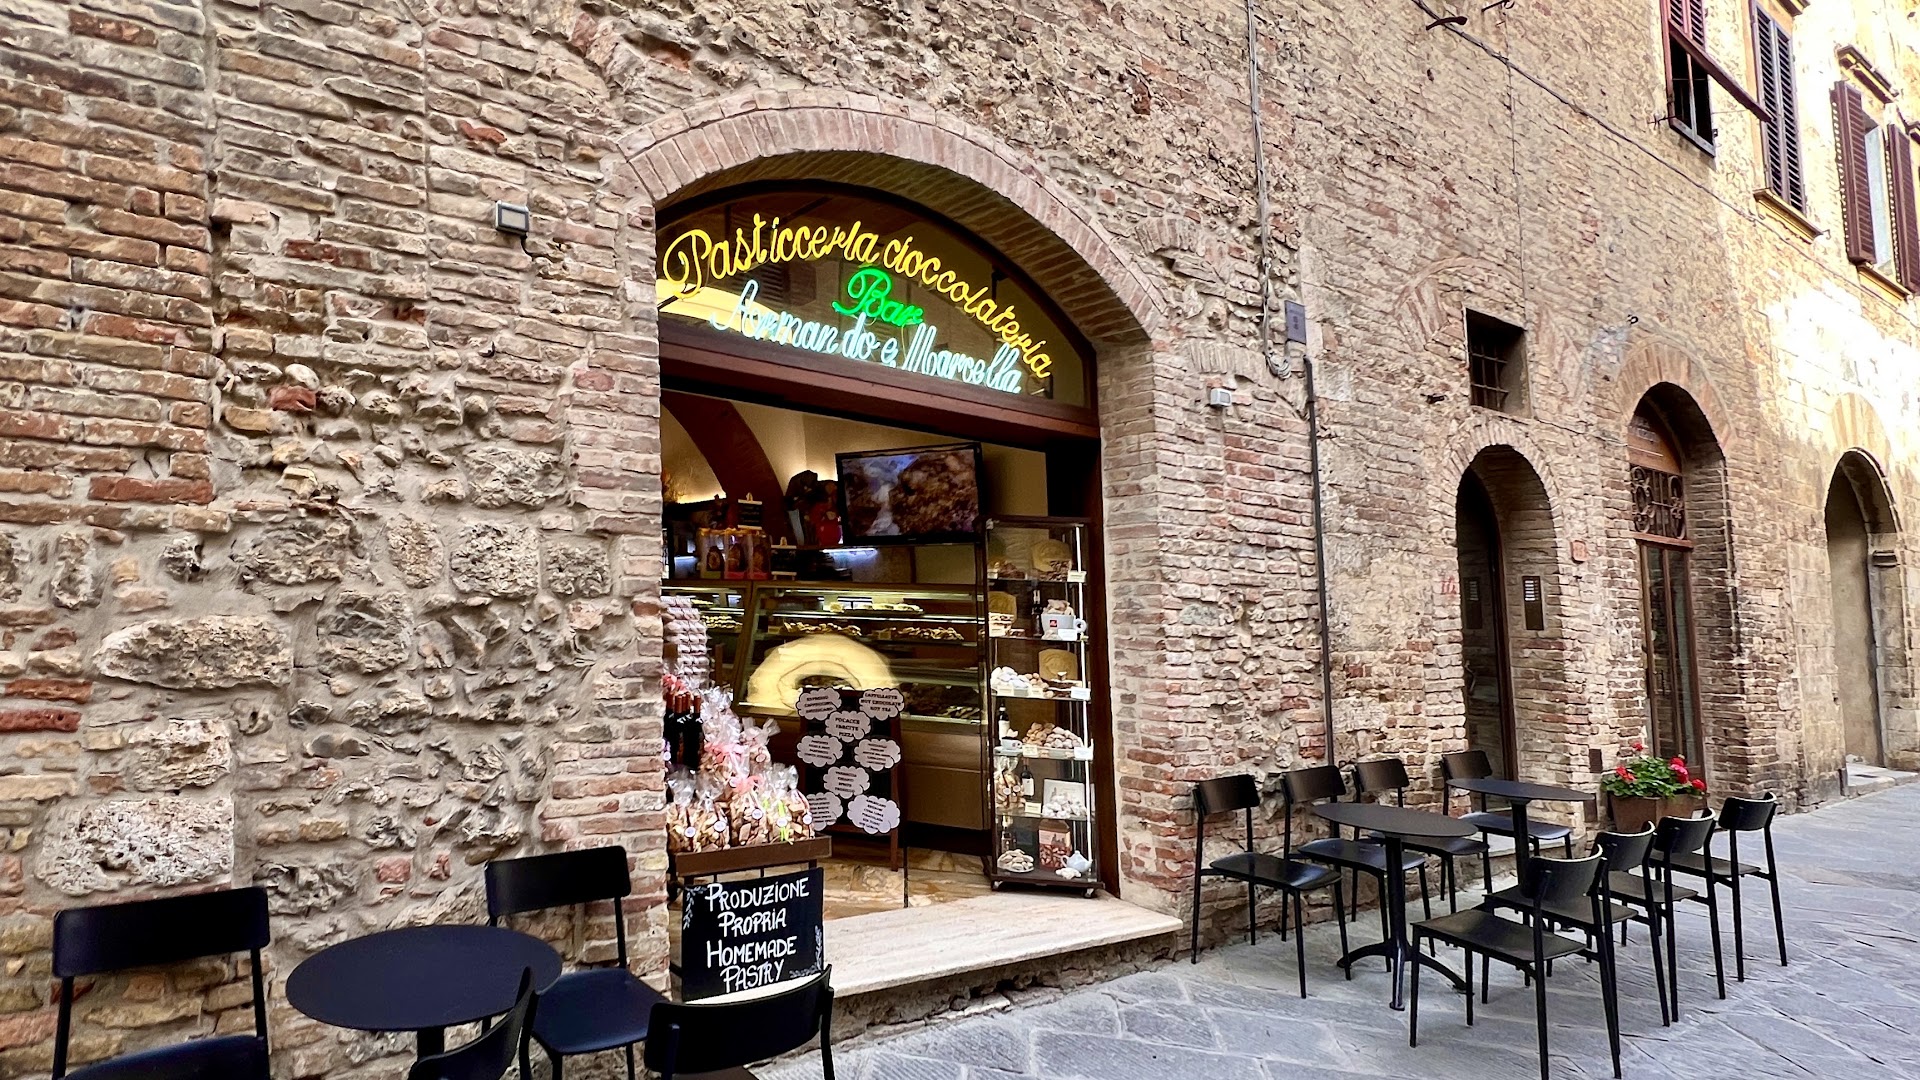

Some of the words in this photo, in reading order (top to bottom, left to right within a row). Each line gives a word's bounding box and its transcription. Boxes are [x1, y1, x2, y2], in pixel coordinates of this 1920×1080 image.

[663, 213, 881, 298] Pasticceria
[882, 235, 1052, 379] cioccolateria
[832, 267, 925, 327] Bar
[880, 337, 899, 366] e
[902, 323, 1022, 394] Marcella
[704, 877, 810, 912] PRODUZIONE
[717, 907, 787, 938] PROPRIA
[706, 935, 798, 969] HOMEMADE
[719, 959, 785, 993] PASTRY
